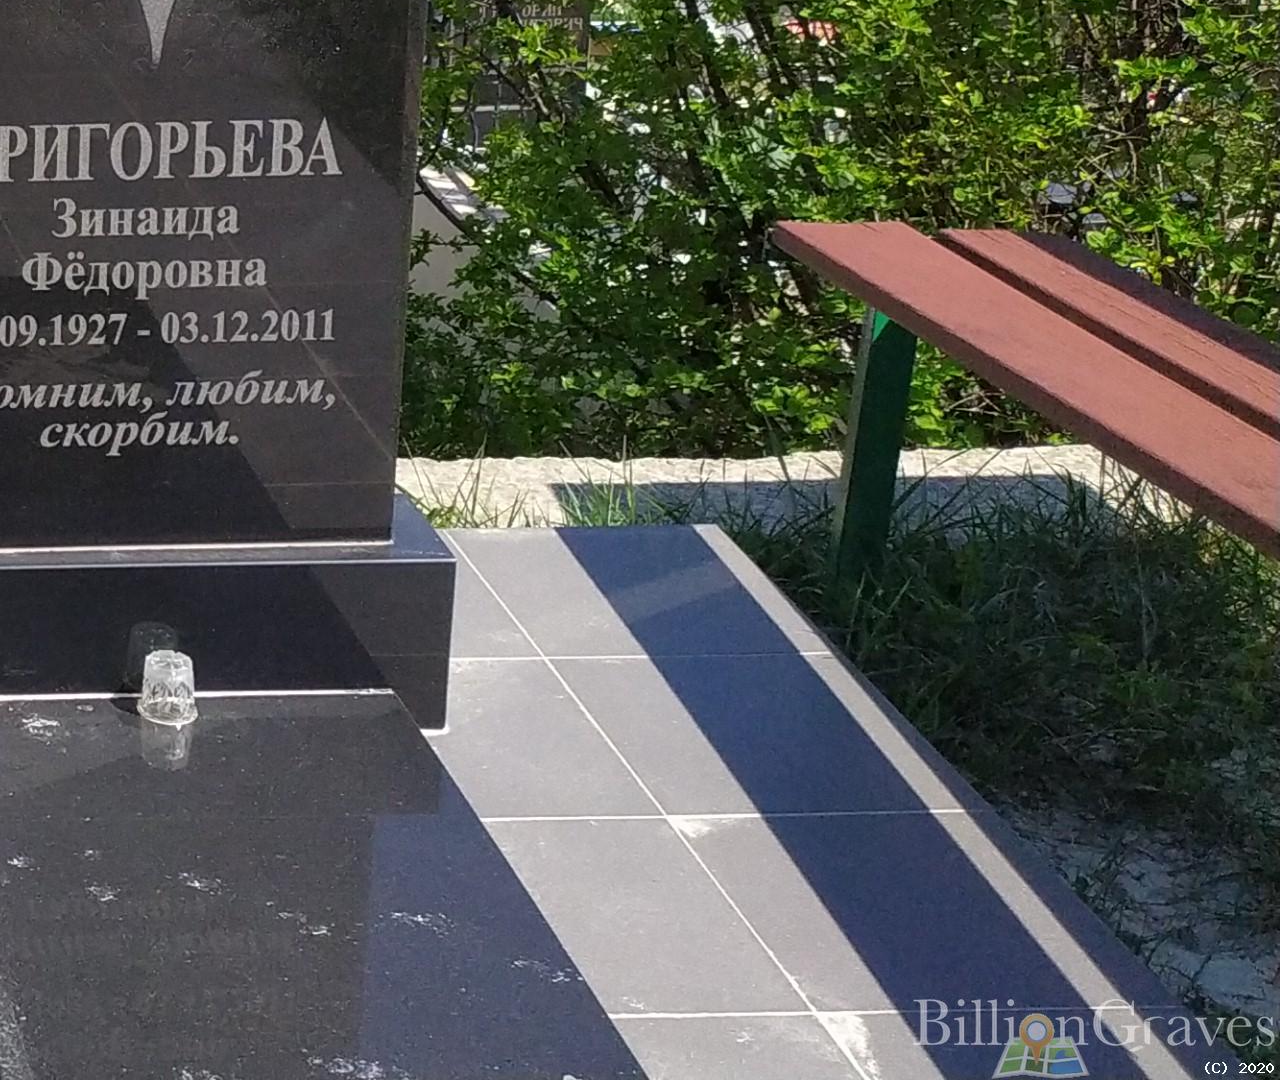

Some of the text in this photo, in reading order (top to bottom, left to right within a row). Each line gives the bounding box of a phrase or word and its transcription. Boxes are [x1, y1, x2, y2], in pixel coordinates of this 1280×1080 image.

[51, 197, 240, 241] Зинаида
[21, 251, 267, 301] Фёдоровна
[161, 308, 335, 344] 03.12.2011
[165, 369, 336, 411] любим,
[39, 409, 240, 457] скорбим.
